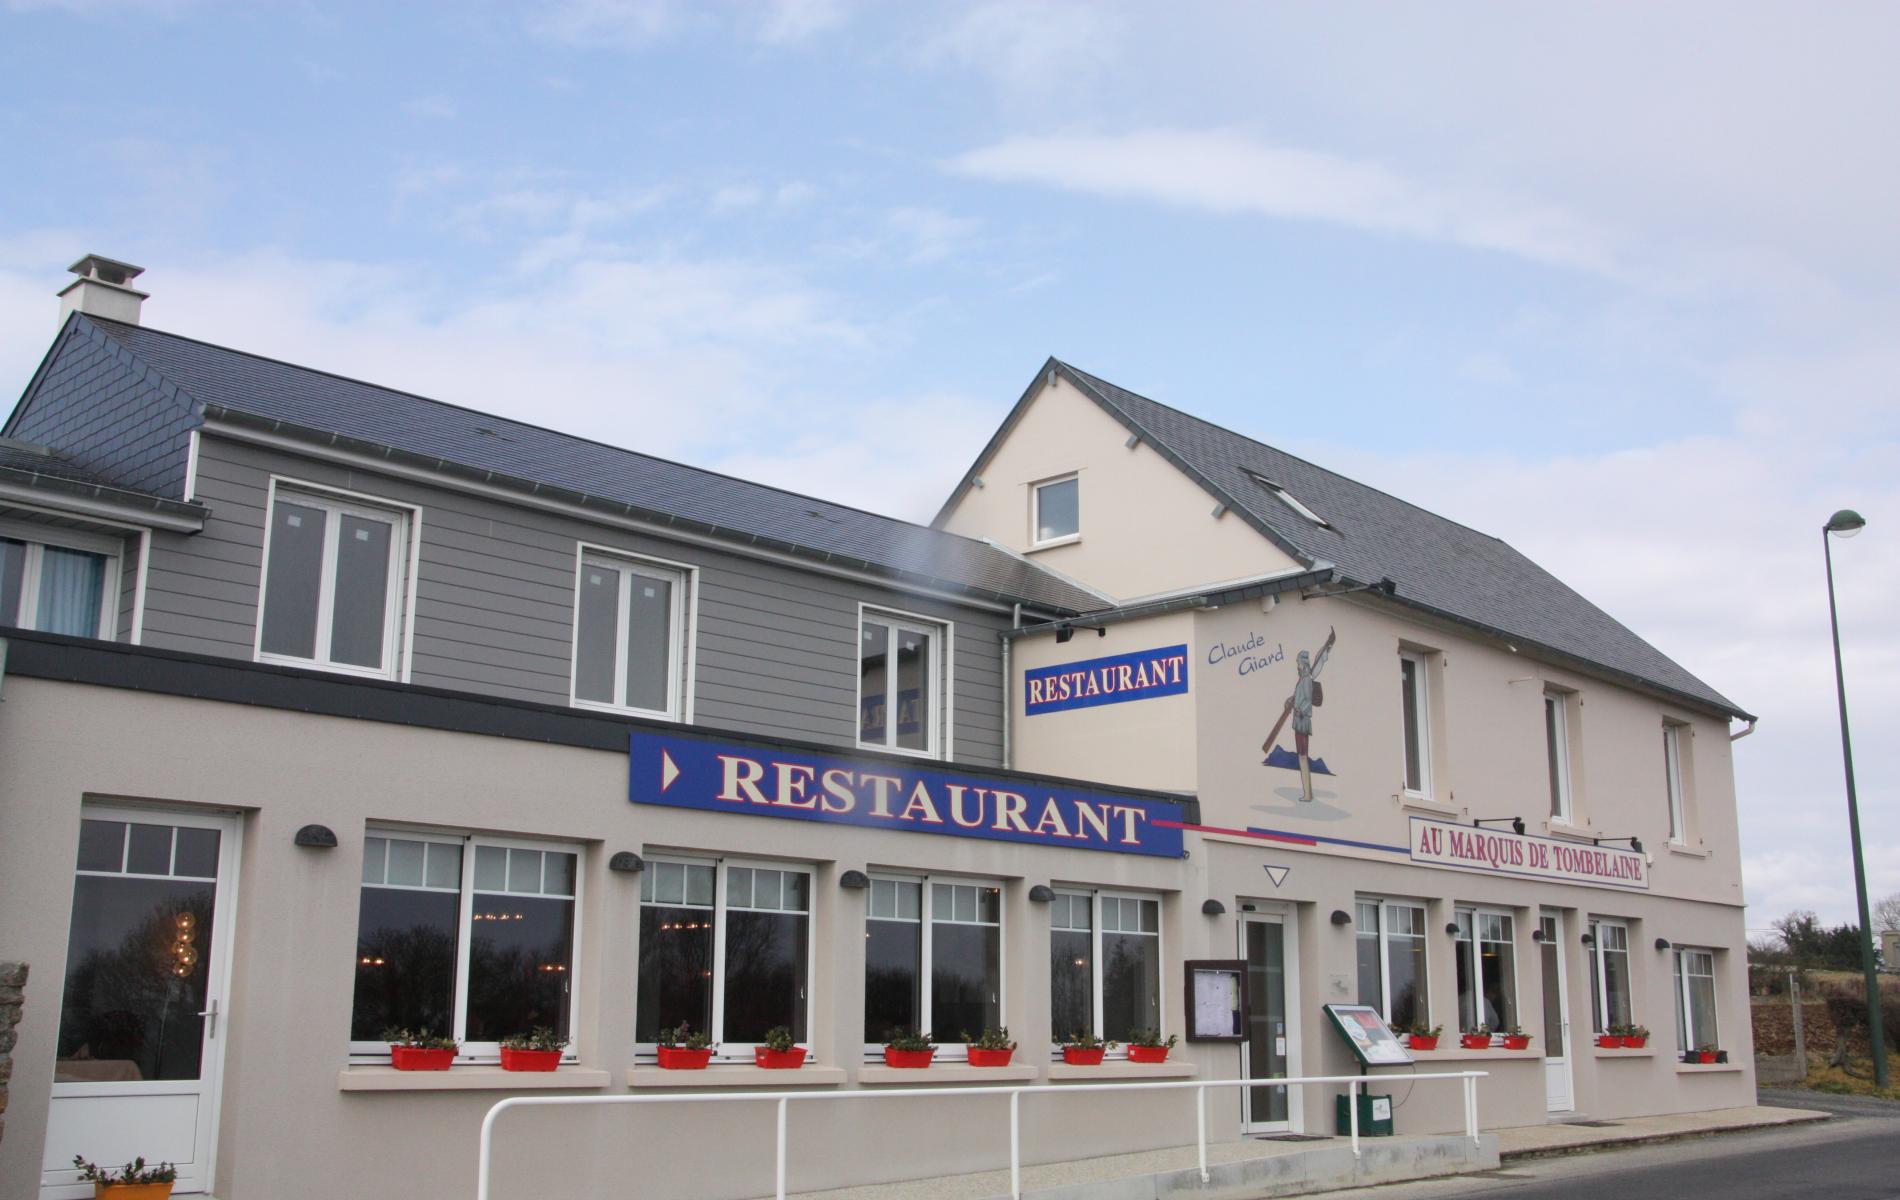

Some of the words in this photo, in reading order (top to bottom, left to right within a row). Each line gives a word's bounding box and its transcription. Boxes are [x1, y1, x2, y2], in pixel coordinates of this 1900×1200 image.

[1208, 632, 1265, 665] Claude
[1238, 643, 1284, 676] Giard
[1029, 656, 1184, 704] RESTAURANT
[716, 754, 1146, 845] RESTAURANT
[1420, 826, 1442, 855] AU
[1449, 830, 1523, 868] MARQUIS
[1528, 842, 1549, 869] DE
[1553, 845, 1642, 880] TOMBELAINE
